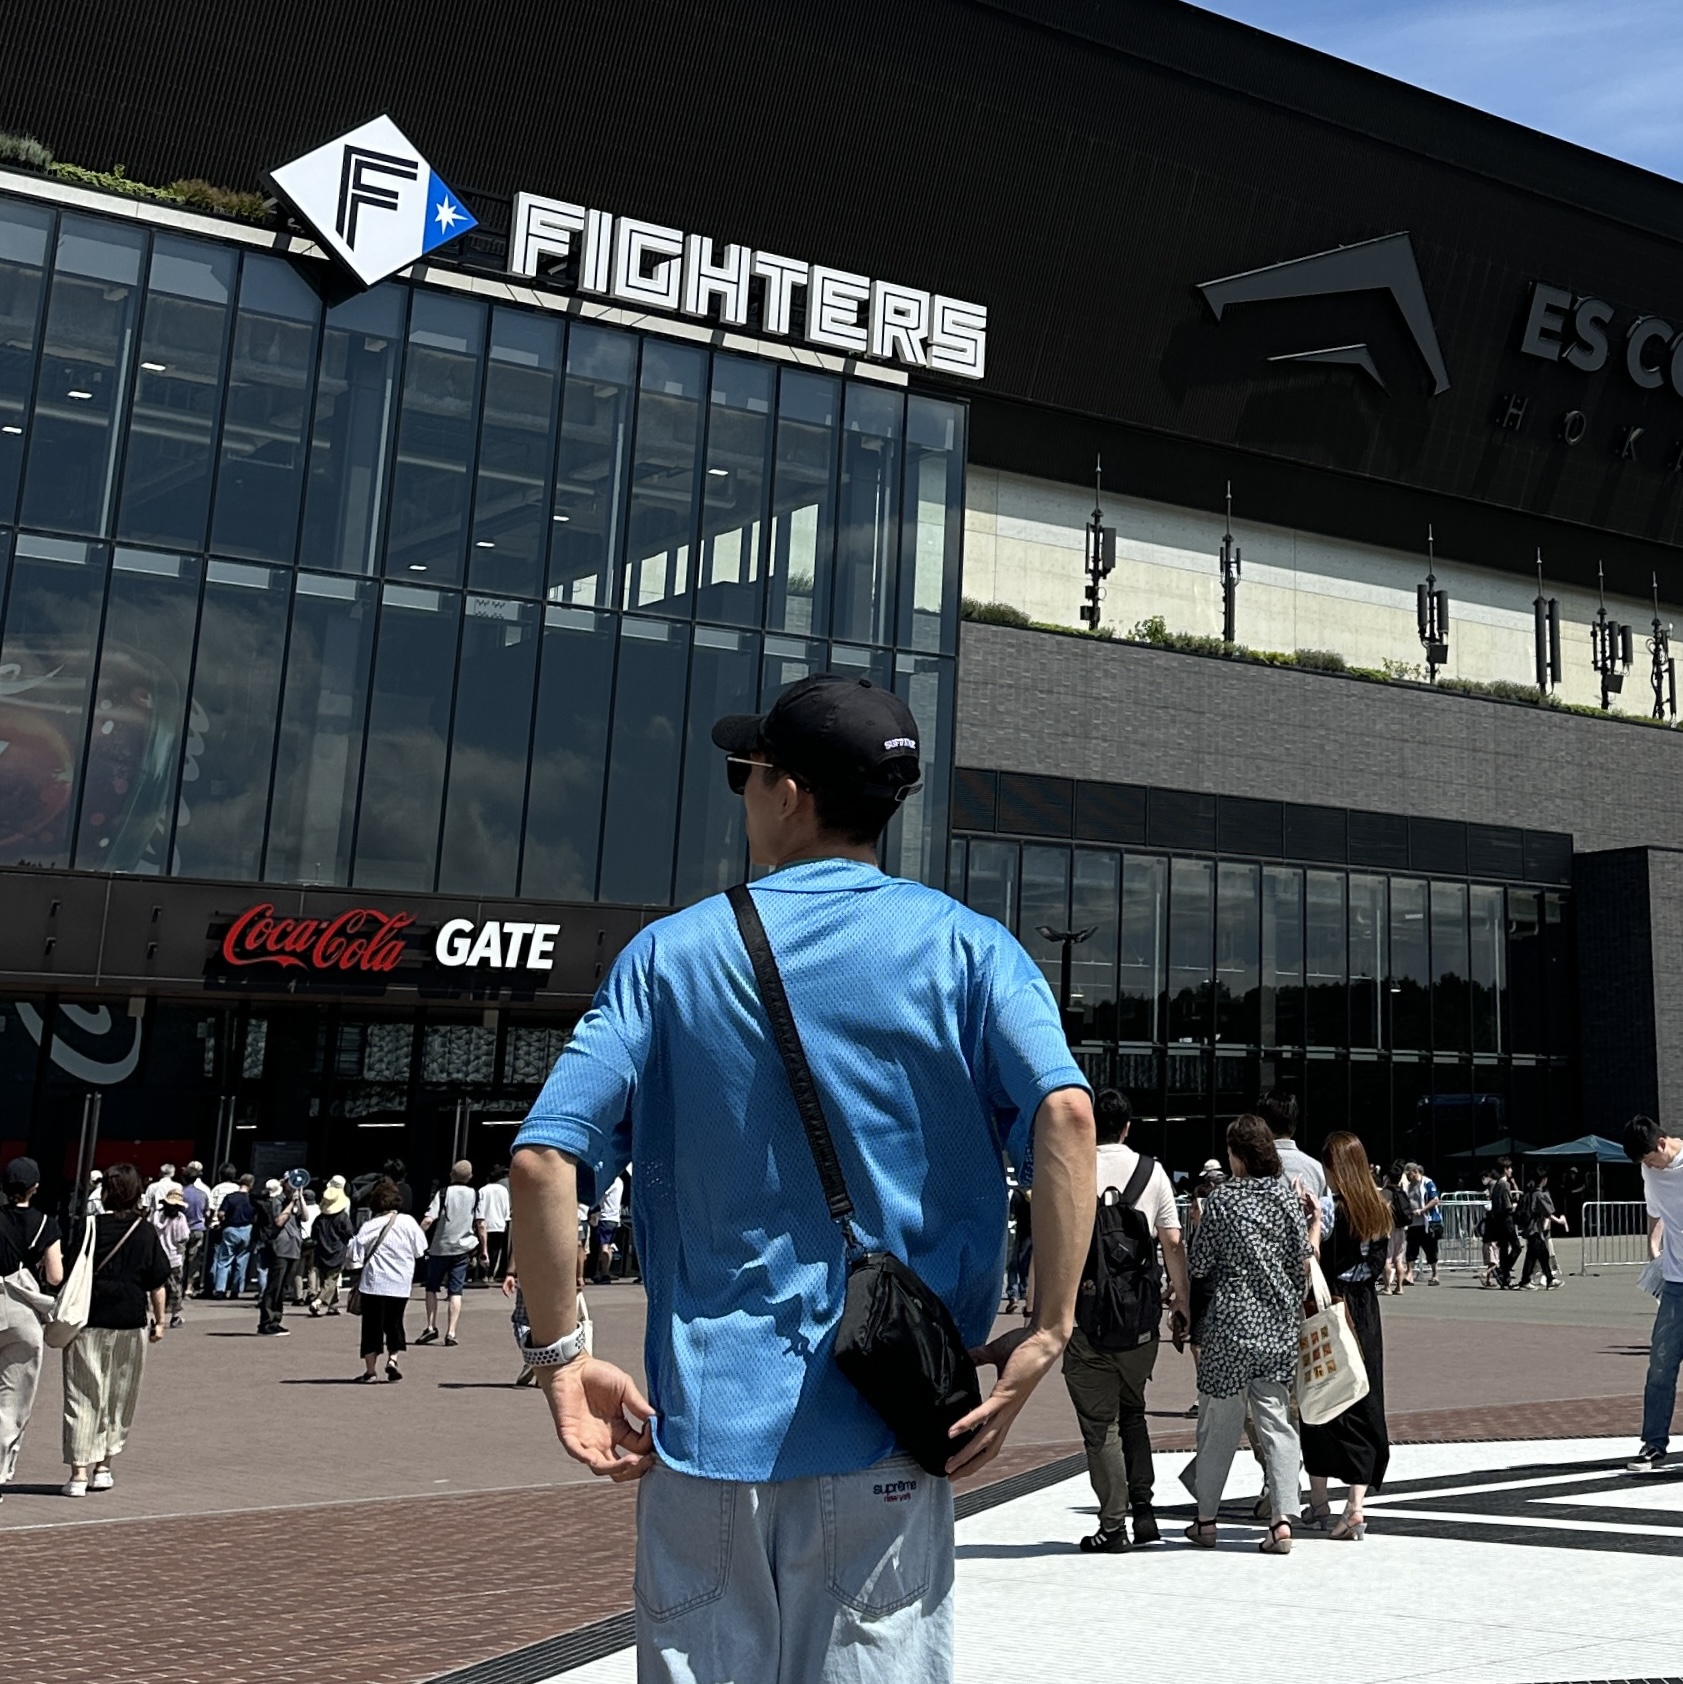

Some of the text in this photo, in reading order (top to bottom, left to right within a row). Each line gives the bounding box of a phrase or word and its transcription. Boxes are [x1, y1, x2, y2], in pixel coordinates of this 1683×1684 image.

[336, 144, 418, 251] F
[508, 191, 988, 380] FIGHTERS
[1626, 314, 1683, 400] C
[222, 903, 561, 973] Coca-Cola GATE
